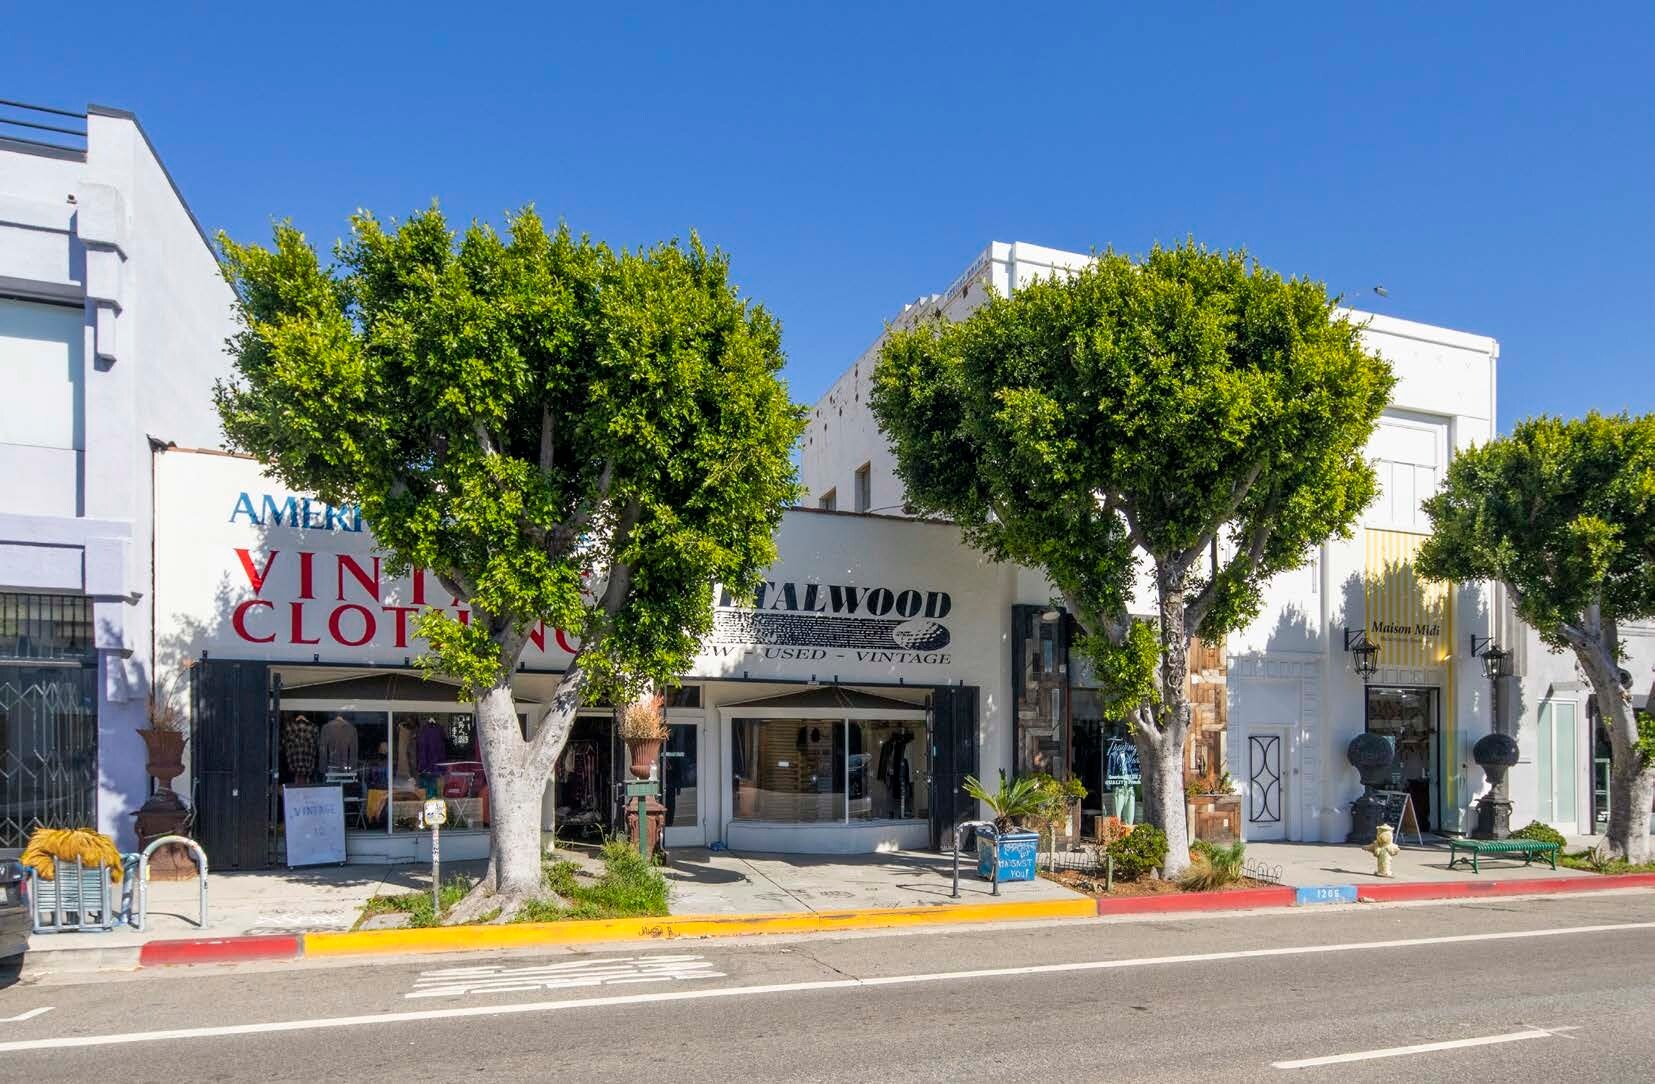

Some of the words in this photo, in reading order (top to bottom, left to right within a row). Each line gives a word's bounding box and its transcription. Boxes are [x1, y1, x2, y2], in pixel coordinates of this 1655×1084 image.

[228, 492, 372, 532] AMERI
[1371, 621, 1412, 635] Maison
[1415, 624, 1440, 636] Midi
[764, 648, 828, 660] USED
[856, 651, 951, 665] VINTAGE
